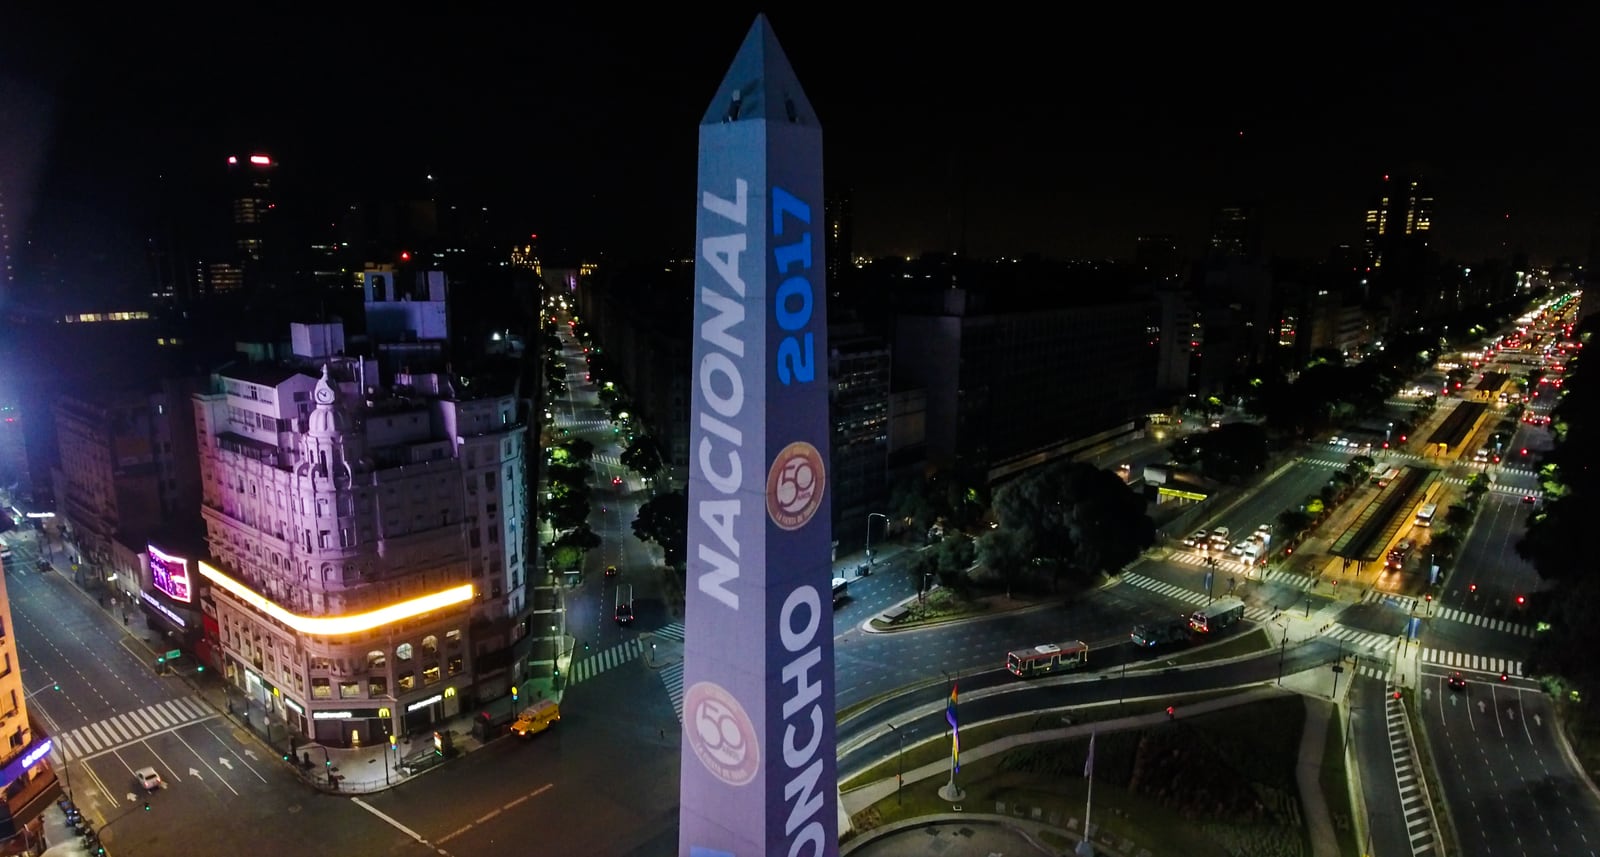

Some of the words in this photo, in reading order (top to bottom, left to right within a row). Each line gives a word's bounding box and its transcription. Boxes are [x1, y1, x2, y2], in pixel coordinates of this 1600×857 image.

[772, 186, 815, 386] 2017
[698, 178, 748, 610] NACIONAL
[780, 463, 814, 506] 50
[700, 701, 744, 750] 50
